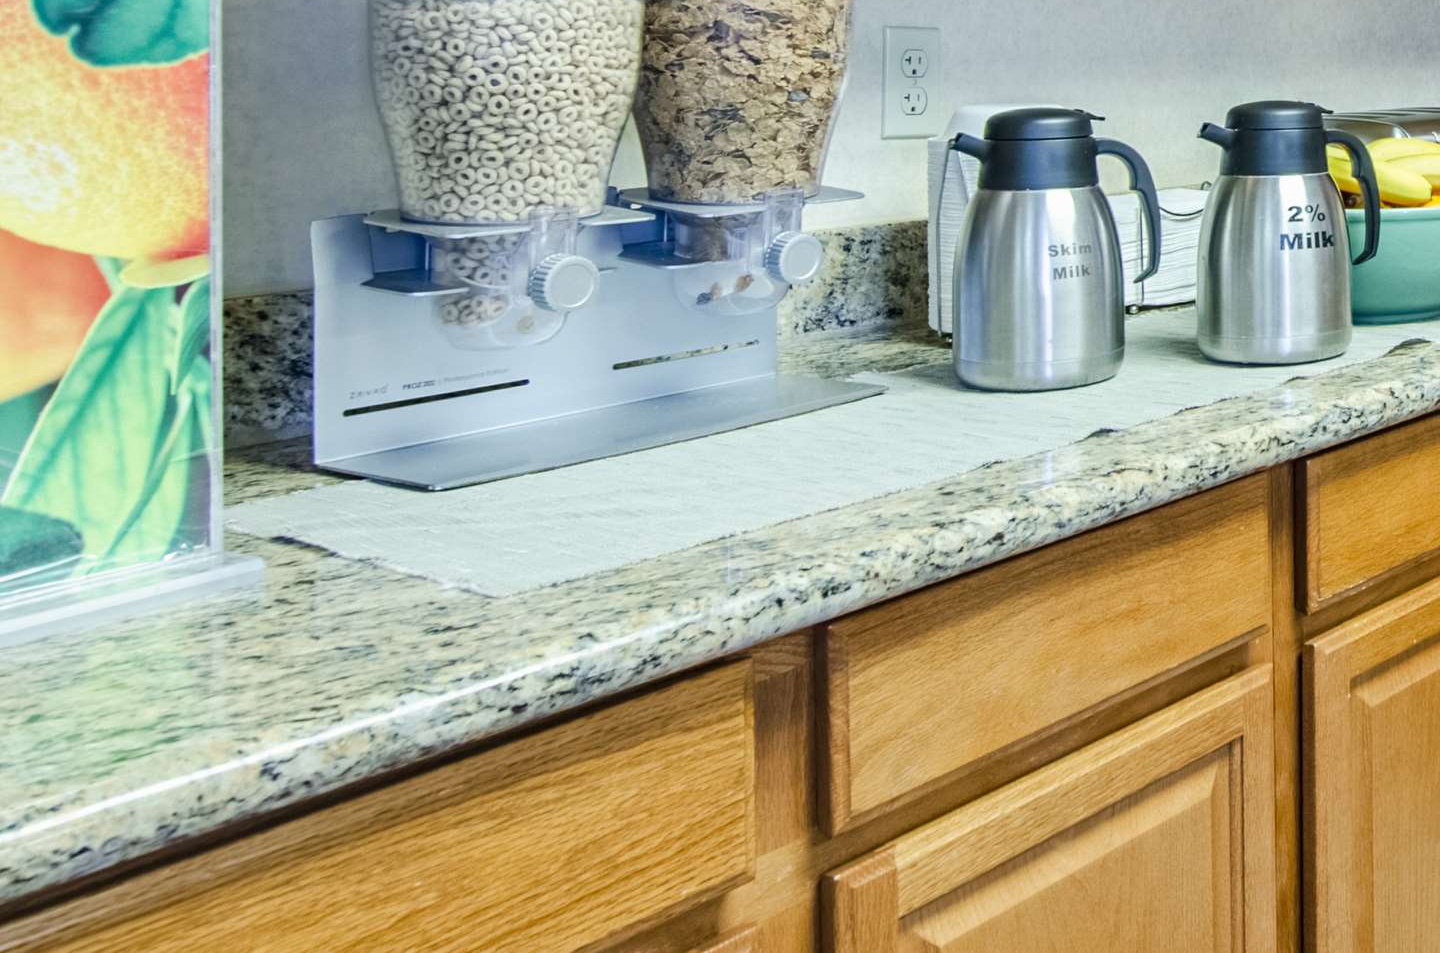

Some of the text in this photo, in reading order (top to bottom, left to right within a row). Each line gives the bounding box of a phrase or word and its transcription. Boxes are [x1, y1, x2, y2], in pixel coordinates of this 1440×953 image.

[1287, 204, 1326, 223] 2%
[1279, 231, 1335, 251] Milk
[1048, 242, 1092, 258] Skim
[1052, 265, 1091, 280] Milk
